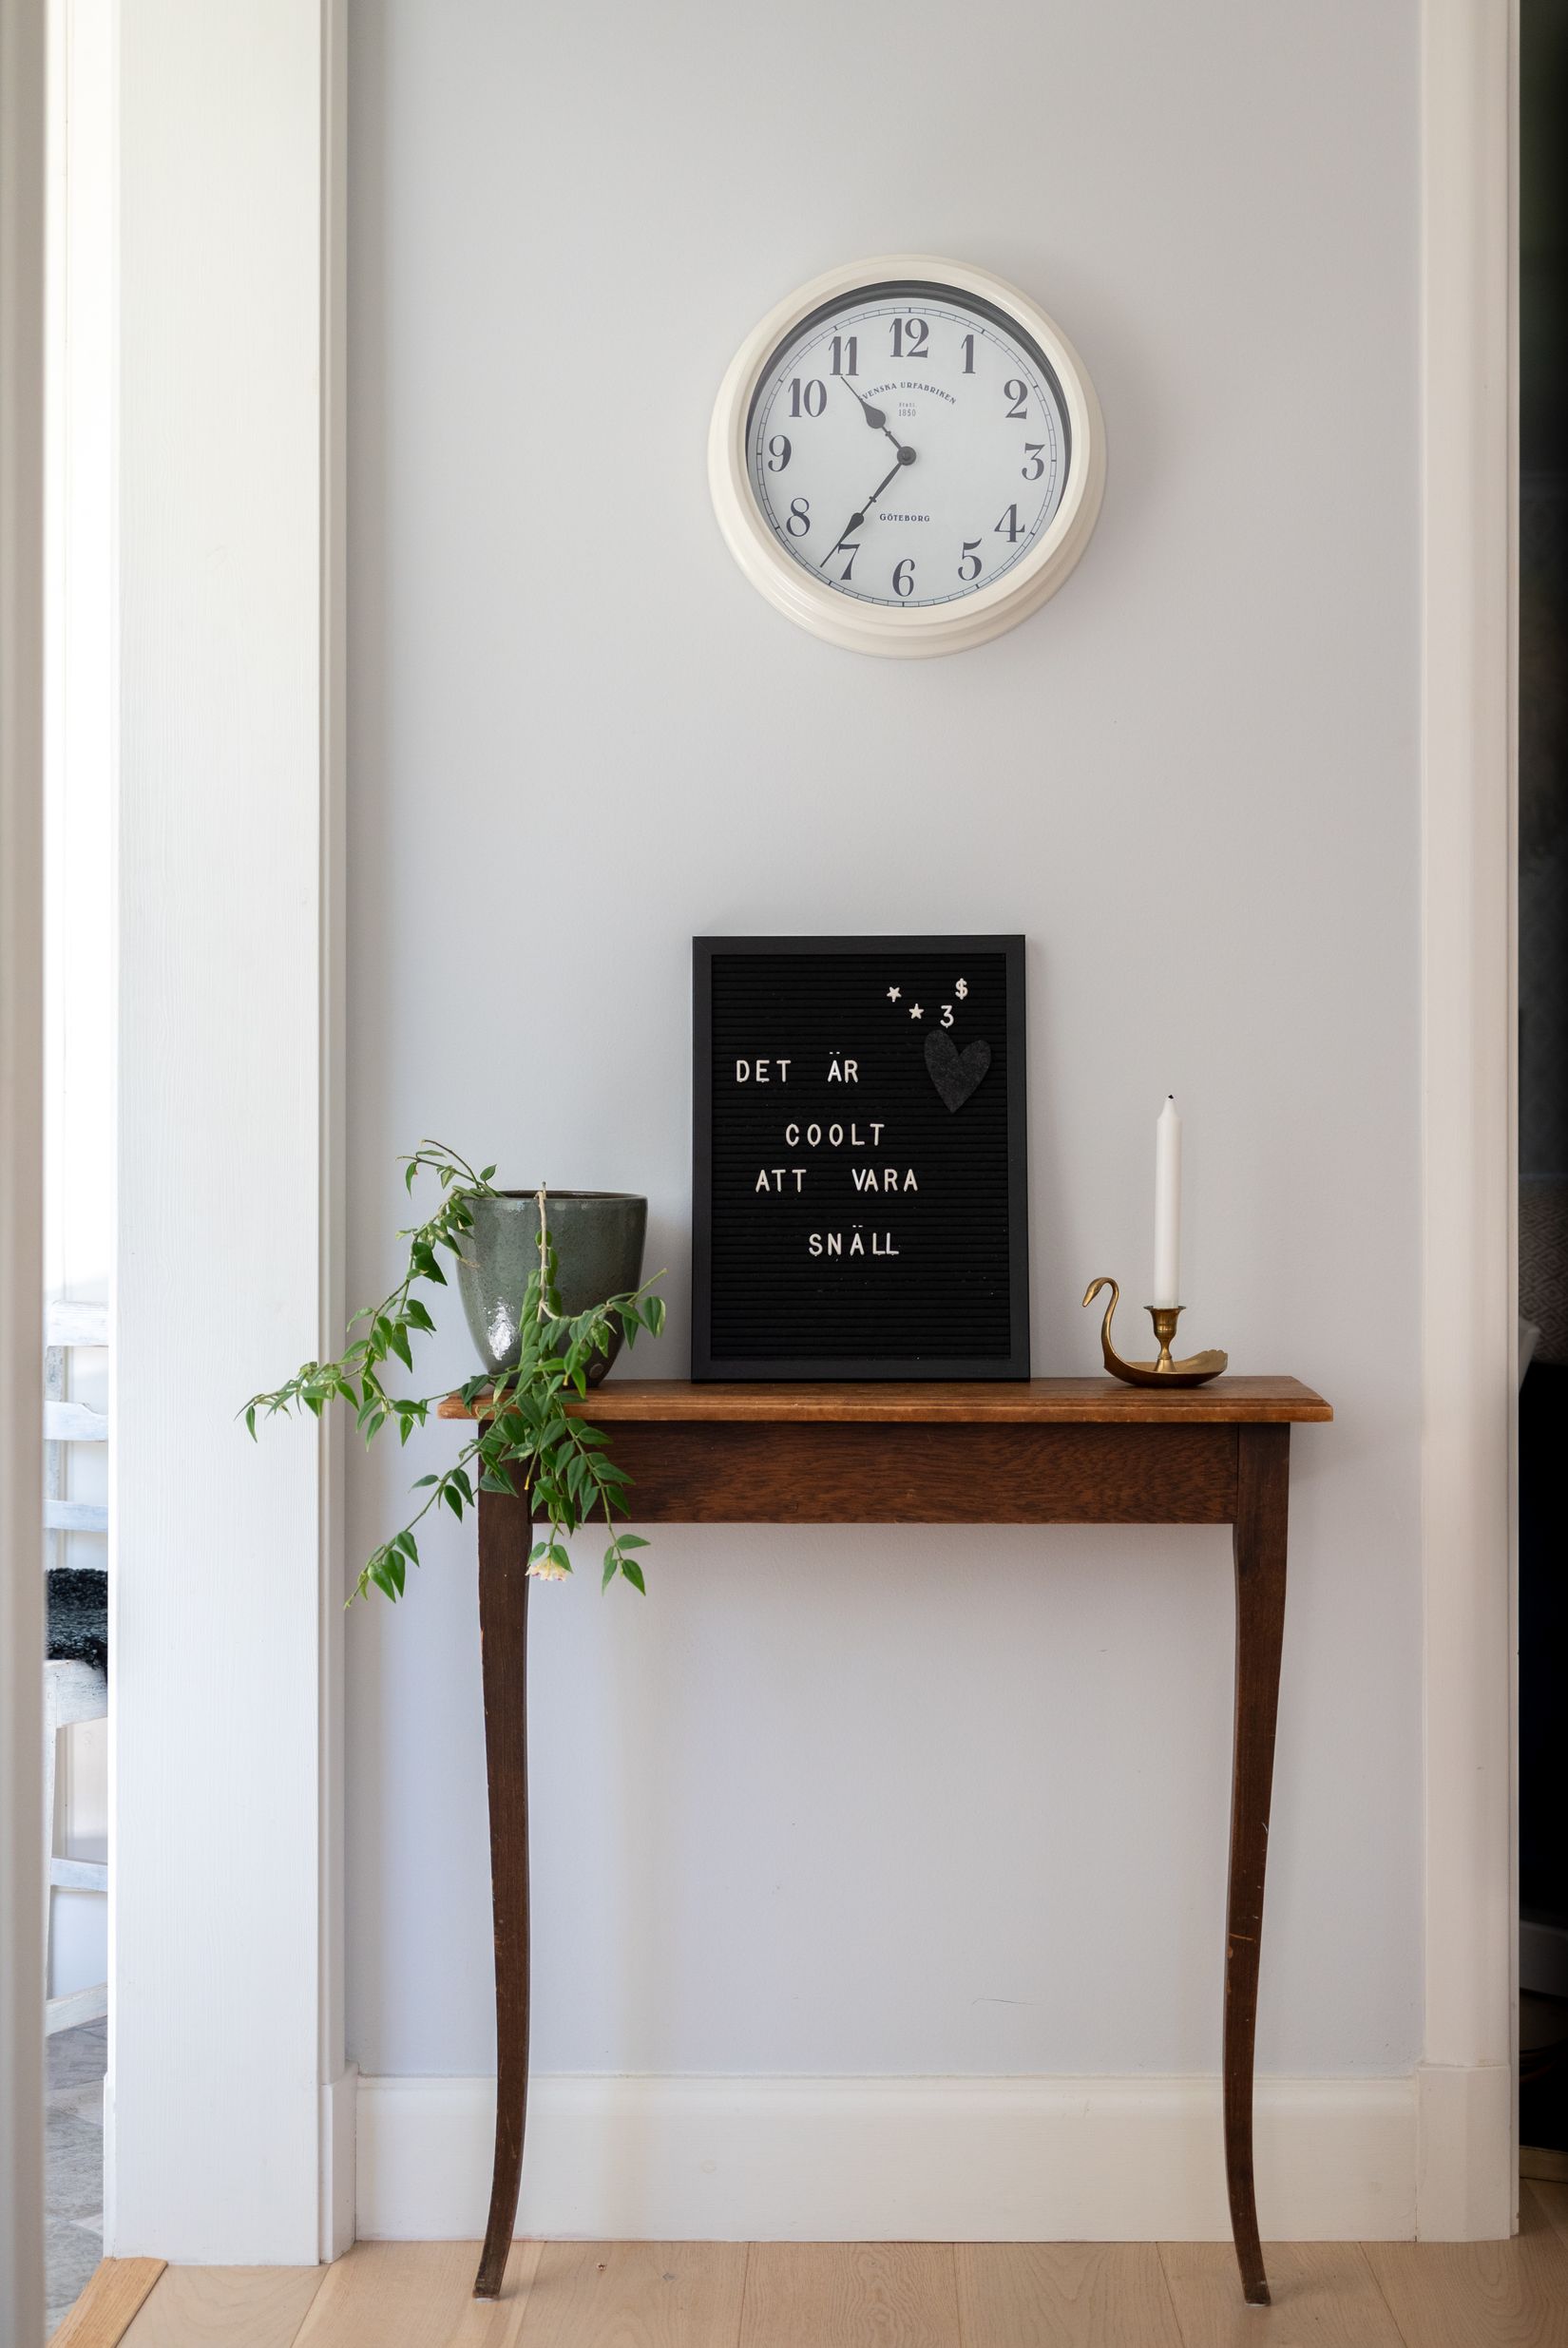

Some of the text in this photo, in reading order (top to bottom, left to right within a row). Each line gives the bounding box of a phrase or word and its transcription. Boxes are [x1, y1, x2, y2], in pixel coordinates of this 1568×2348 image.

[828, 335, 860, 376] 11
[889, 317, 929, 358] 12
[961, 334, 976, 373] 1
[787, 377, 828, 417] 10
[898, 409, 916, 417] 1850
[900, 381, 957, 406] URFABRIKEN
[1004, 379, 1029, 420] 2
[767, 434, 793, 472] 9
[1021, 442, 1045, 481] 3
[786, 497, 811, 538] 8
[879, 512, 930, 523] GÖTEBORG
[993, 503, 1026, 544] 4
[837, 542, 861, 581] 7
[891, 558, 916, 598] 6
[957, 537, 984, 582] 5
[940, 1004, 954, 1028] 3
[736, 1051, 859, 1083] DET ÄR
[786, 1123, 885, 1147] COOLT
[755, 1169, 919, 1193] ATT VARA
[809, 1225, 900, 1256] SNÄLL
